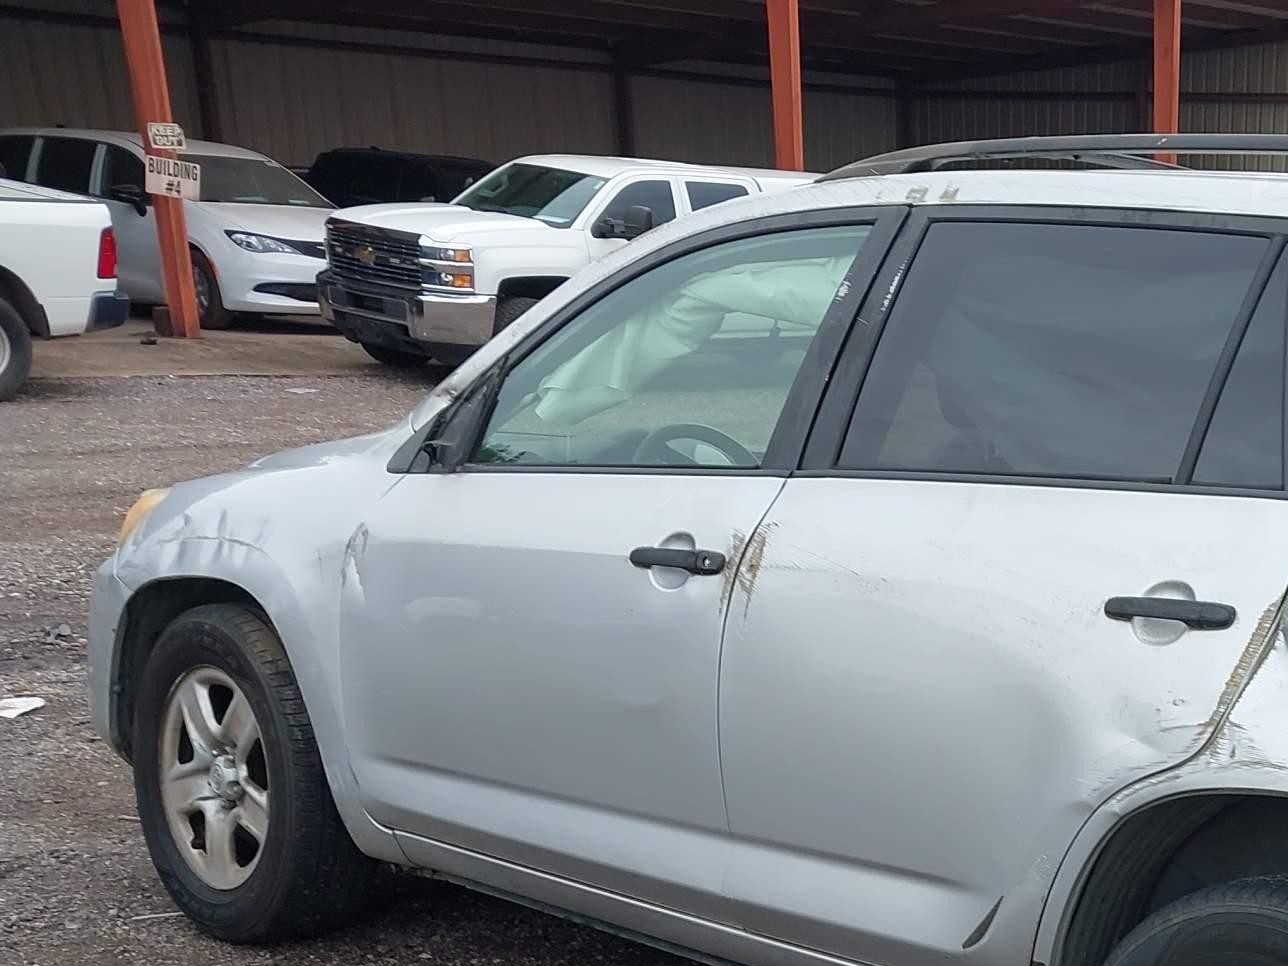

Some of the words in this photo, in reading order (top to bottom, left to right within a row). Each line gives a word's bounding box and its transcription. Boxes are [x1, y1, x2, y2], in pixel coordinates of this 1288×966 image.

[151, 126, 182, 136] KEEP
[154, 136, 180, 146] OUT
[148, 157, 198, 181] BUILDING
[165, 180, 181, 196] #4
